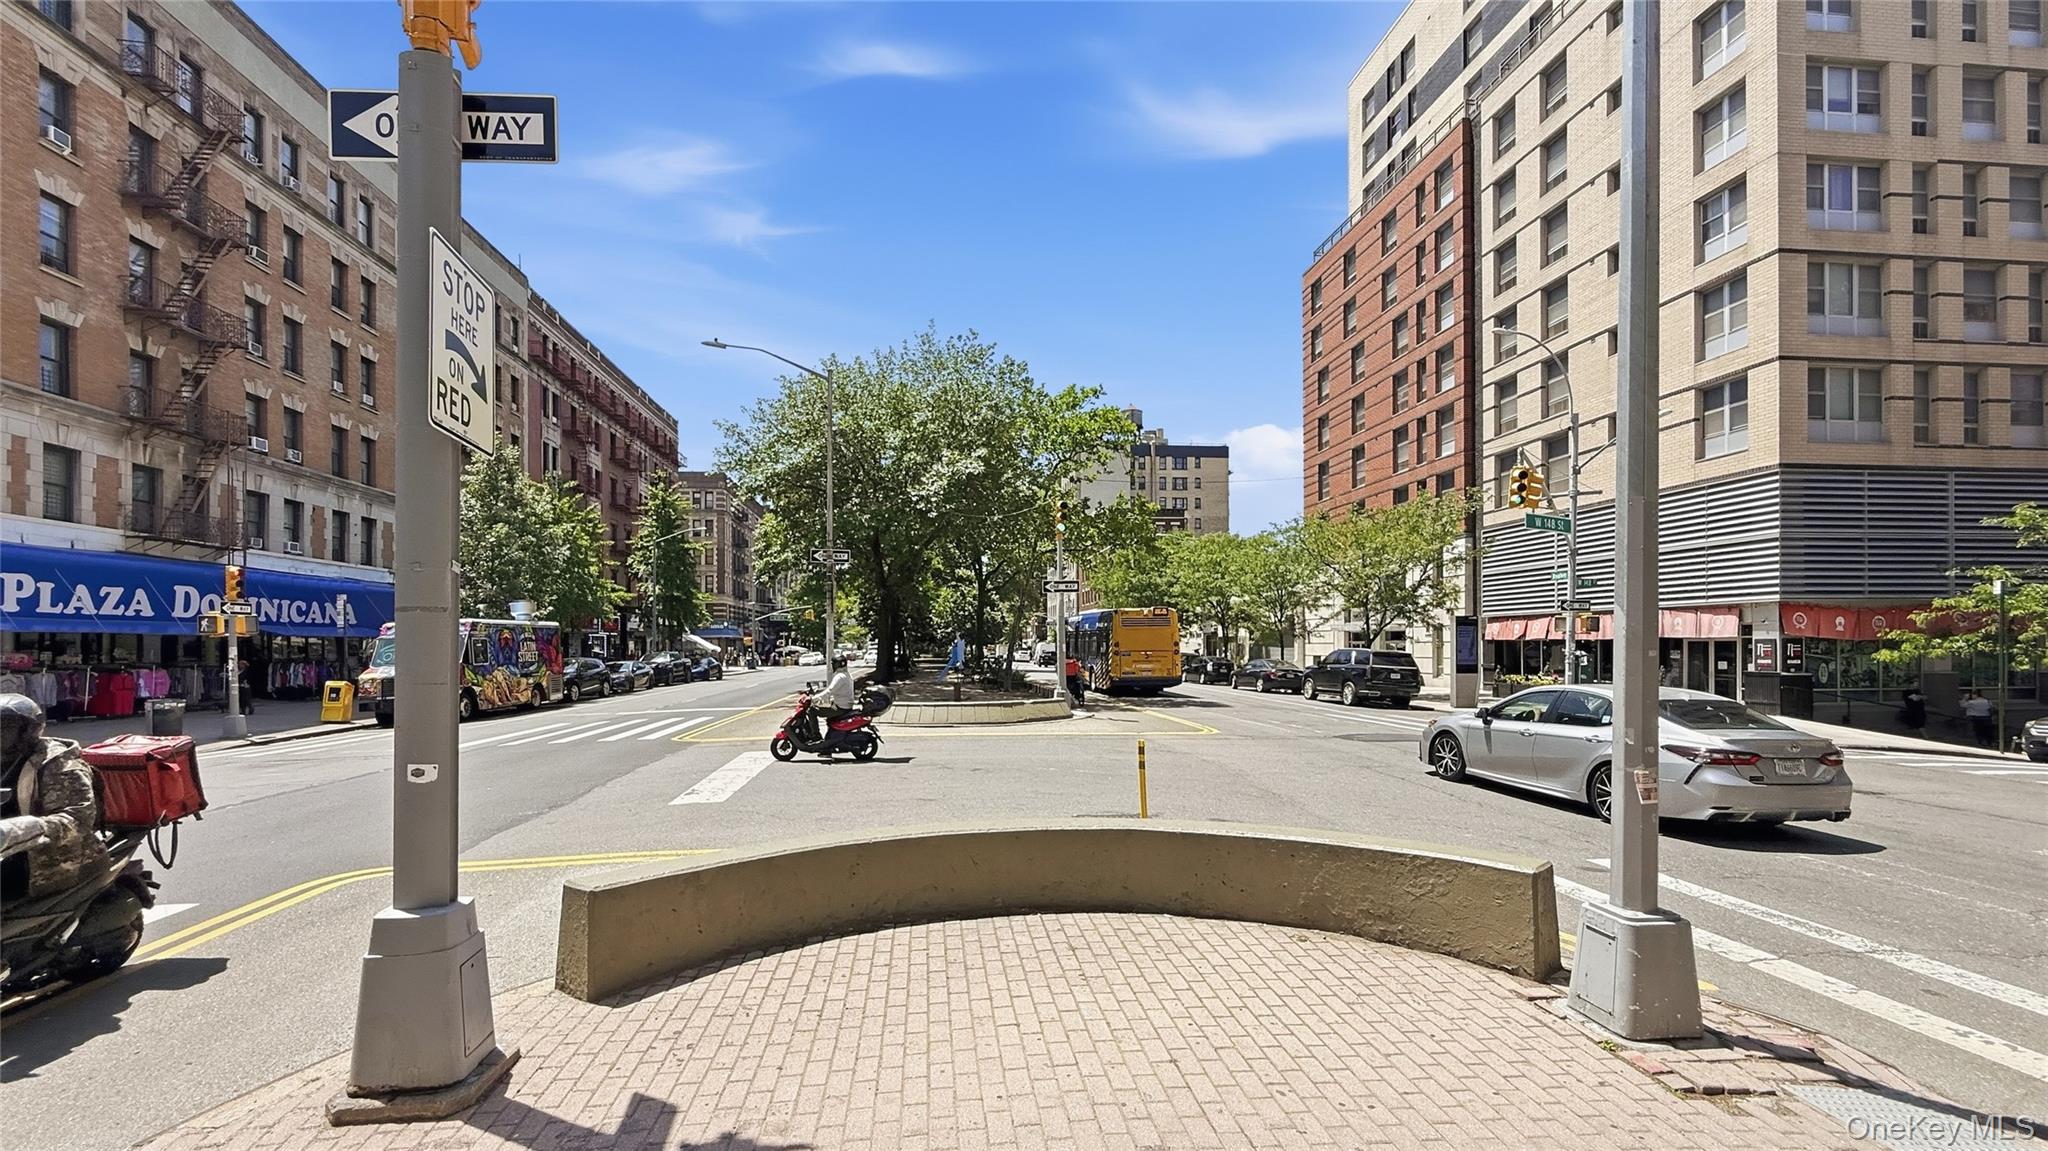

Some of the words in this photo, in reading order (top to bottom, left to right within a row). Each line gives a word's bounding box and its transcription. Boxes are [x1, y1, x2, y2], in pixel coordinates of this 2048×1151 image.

[467, 115, 531, 140] WAY
[443, 260, 485, 321] STOP
[451, 307, 478, 347] HERE
[449, 357, 464, 385] ON
[437, 376, 471, 427] RED
[1534, 517, 1542, 527] W
[1544, 519, 1556, 529] 148
[0, 572, 155, 617] PLAZA
[170, 585, 358, 624] DOINICANA
[518, 652, 539, 662] STREET
[520, 642, 536, 651] LATIN
